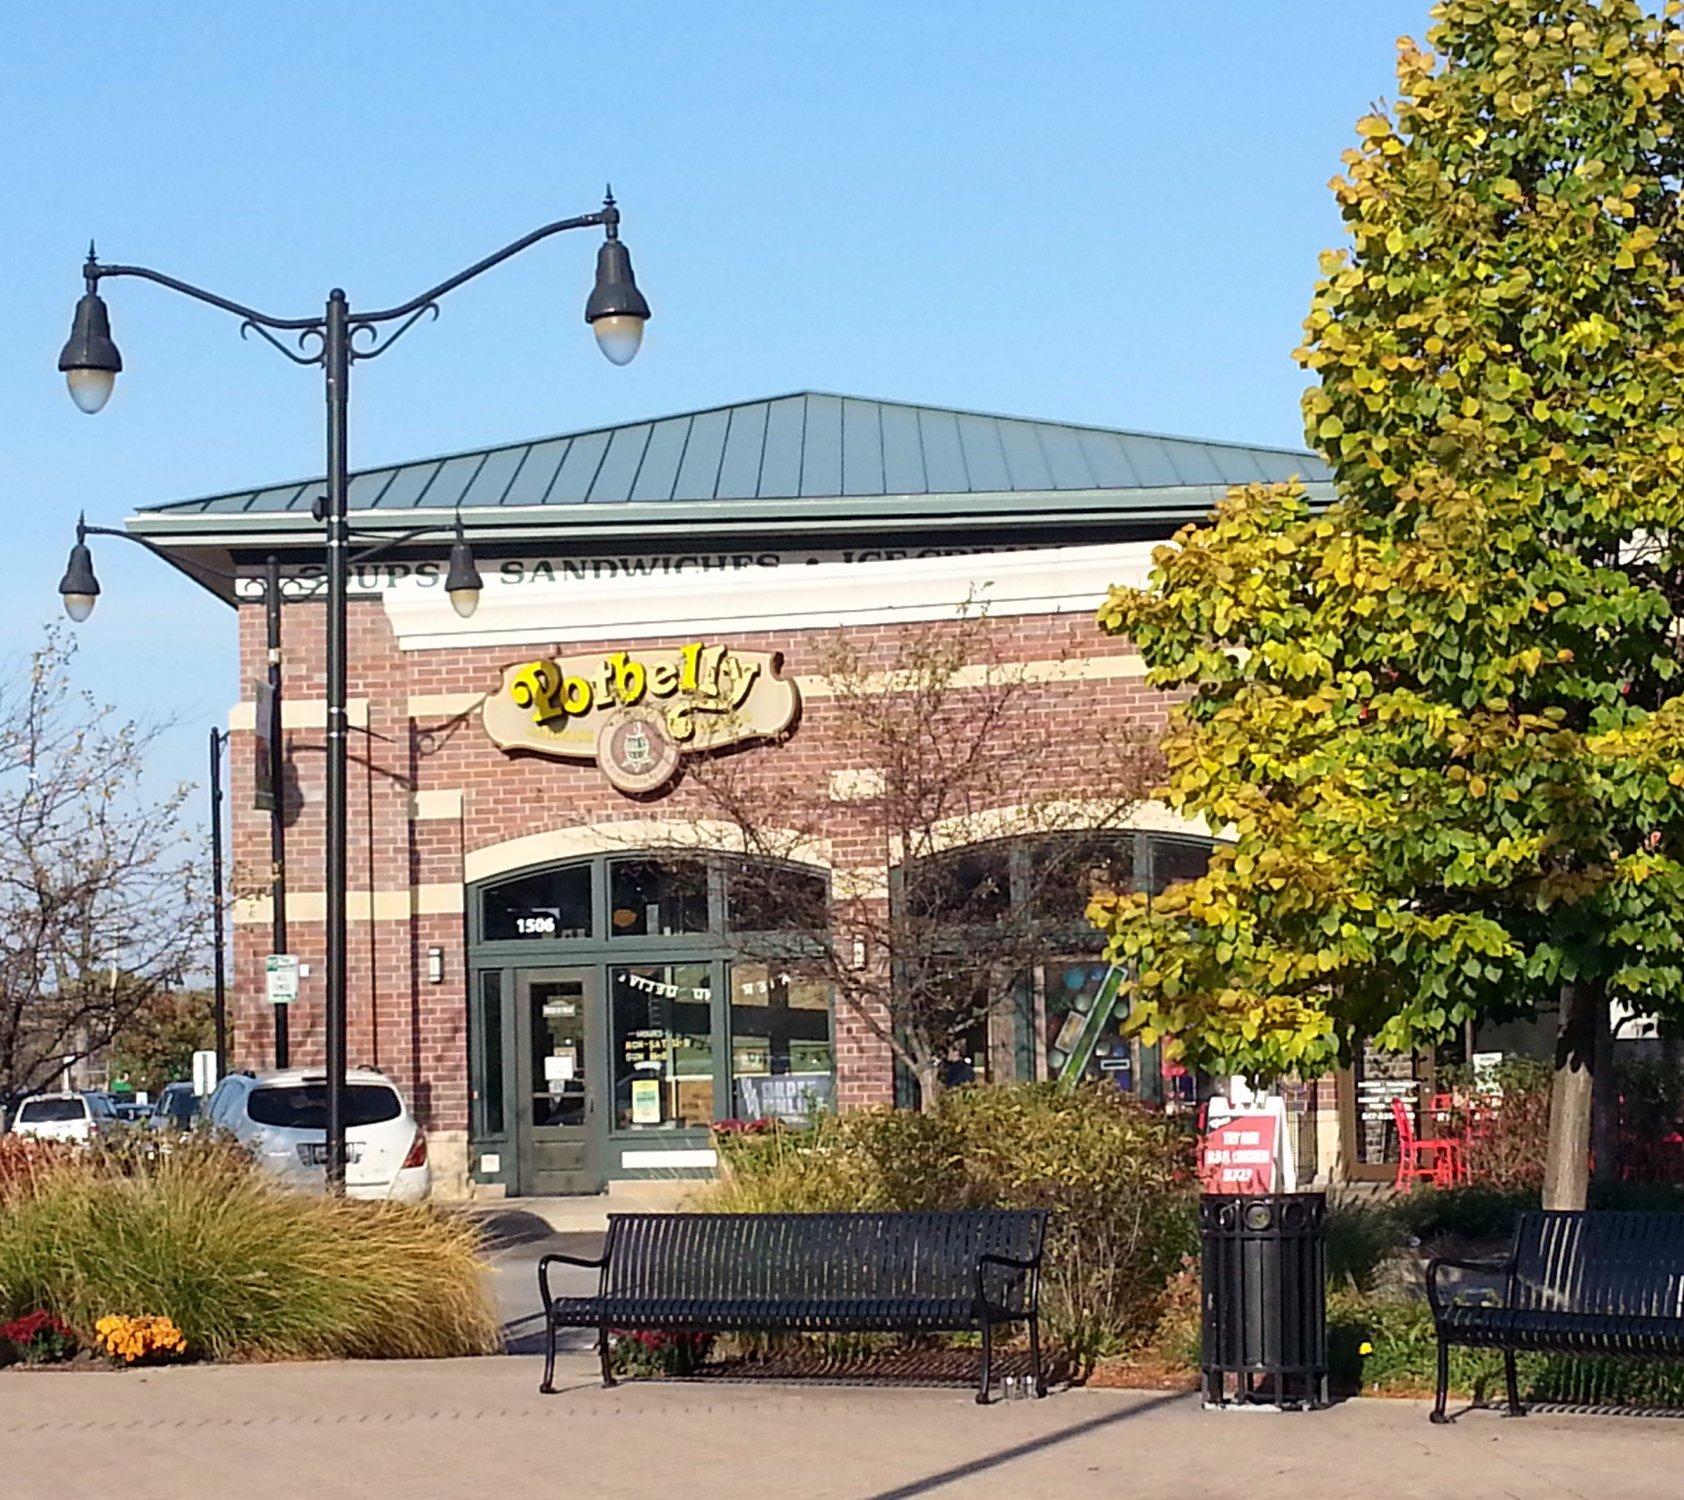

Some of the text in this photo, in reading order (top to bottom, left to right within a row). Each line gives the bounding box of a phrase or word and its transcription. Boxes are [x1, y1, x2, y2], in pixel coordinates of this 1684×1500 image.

[299, 563, 441, 590] SUPS
[510, 642, 762, 739] Potbelly
[516, 917, 556, 934] 1506
